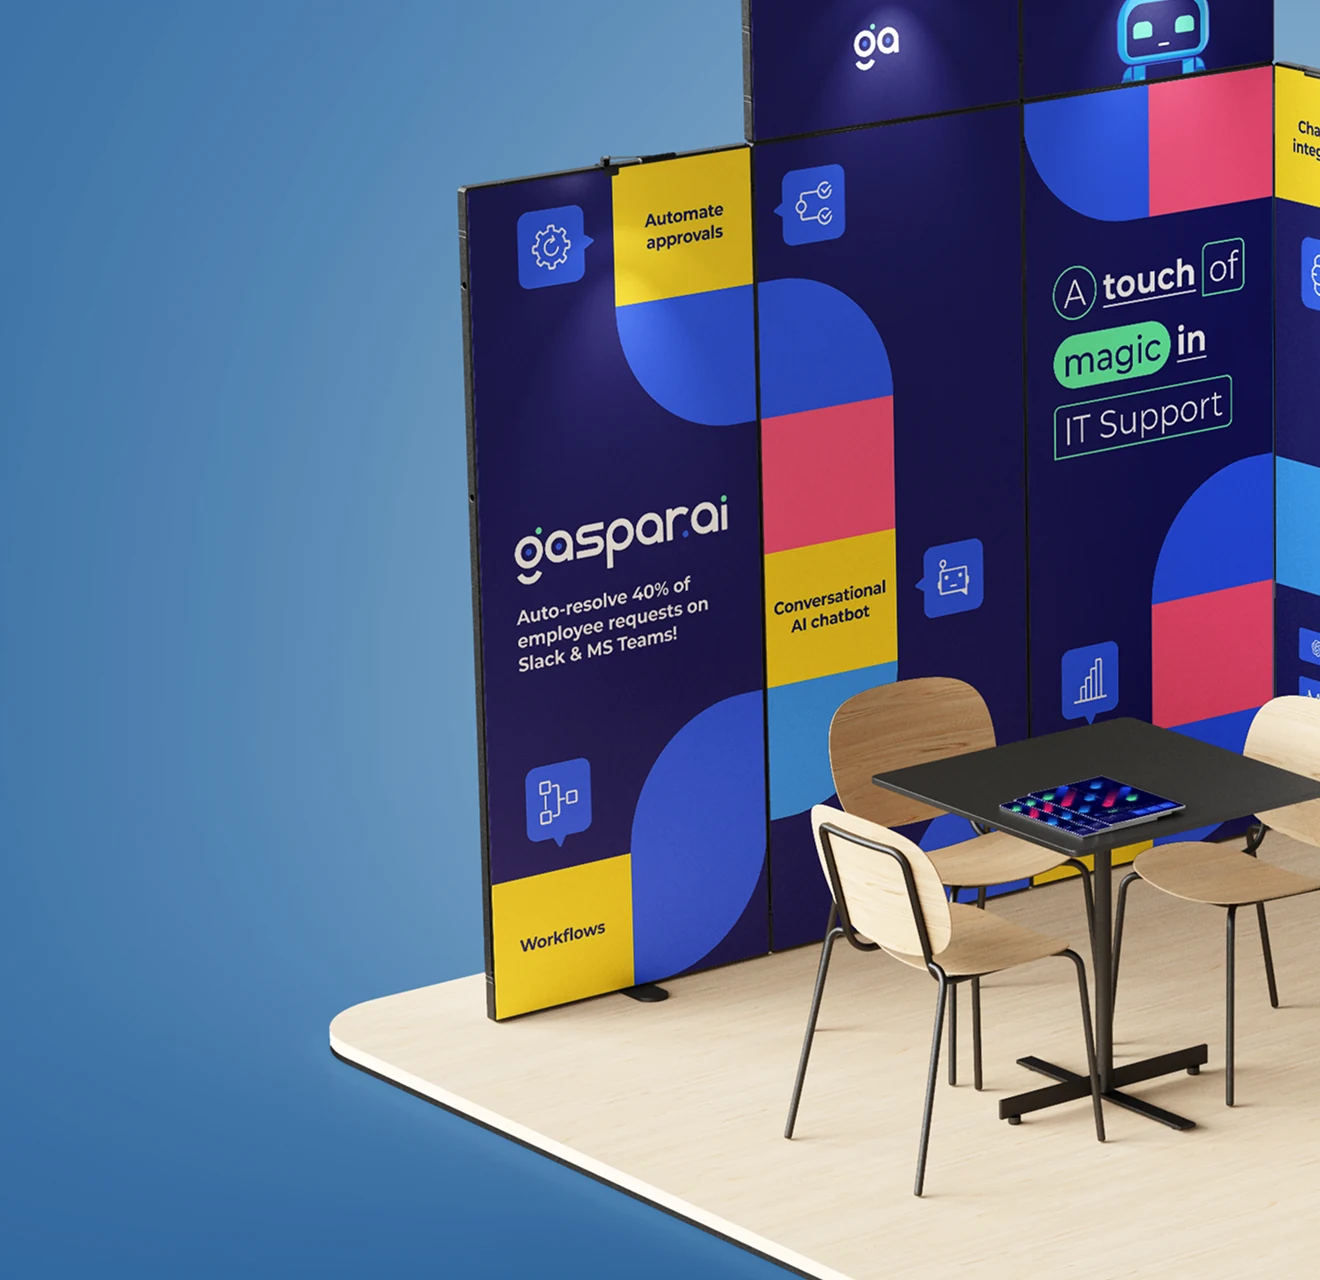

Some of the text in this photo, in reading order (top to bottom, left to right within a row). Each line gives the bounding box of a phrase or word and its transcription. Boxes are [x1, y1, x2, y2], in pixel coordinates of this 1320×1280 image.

[644, 204, 724, 228] Automate
[646, 224, 724, 251] approvals
[1063, 249, 1239, 309] A touch of
[1064, 324, 1206, 378] magic in
[1066, 392, 1223, 446] IT Support
[514, 494, 729, 585] gaspar.ai
[516, 575, 691, 626] Auto-resolve 40% of
[773, 579, 886, 615] Conversational
[790, 605, 870, 633] AI chatbot
[517, 599, 709, 649] employee requests on
[518, 625, 678, 673] Slack & MS Teams!
[519, 920, 606, 953] Workflows
